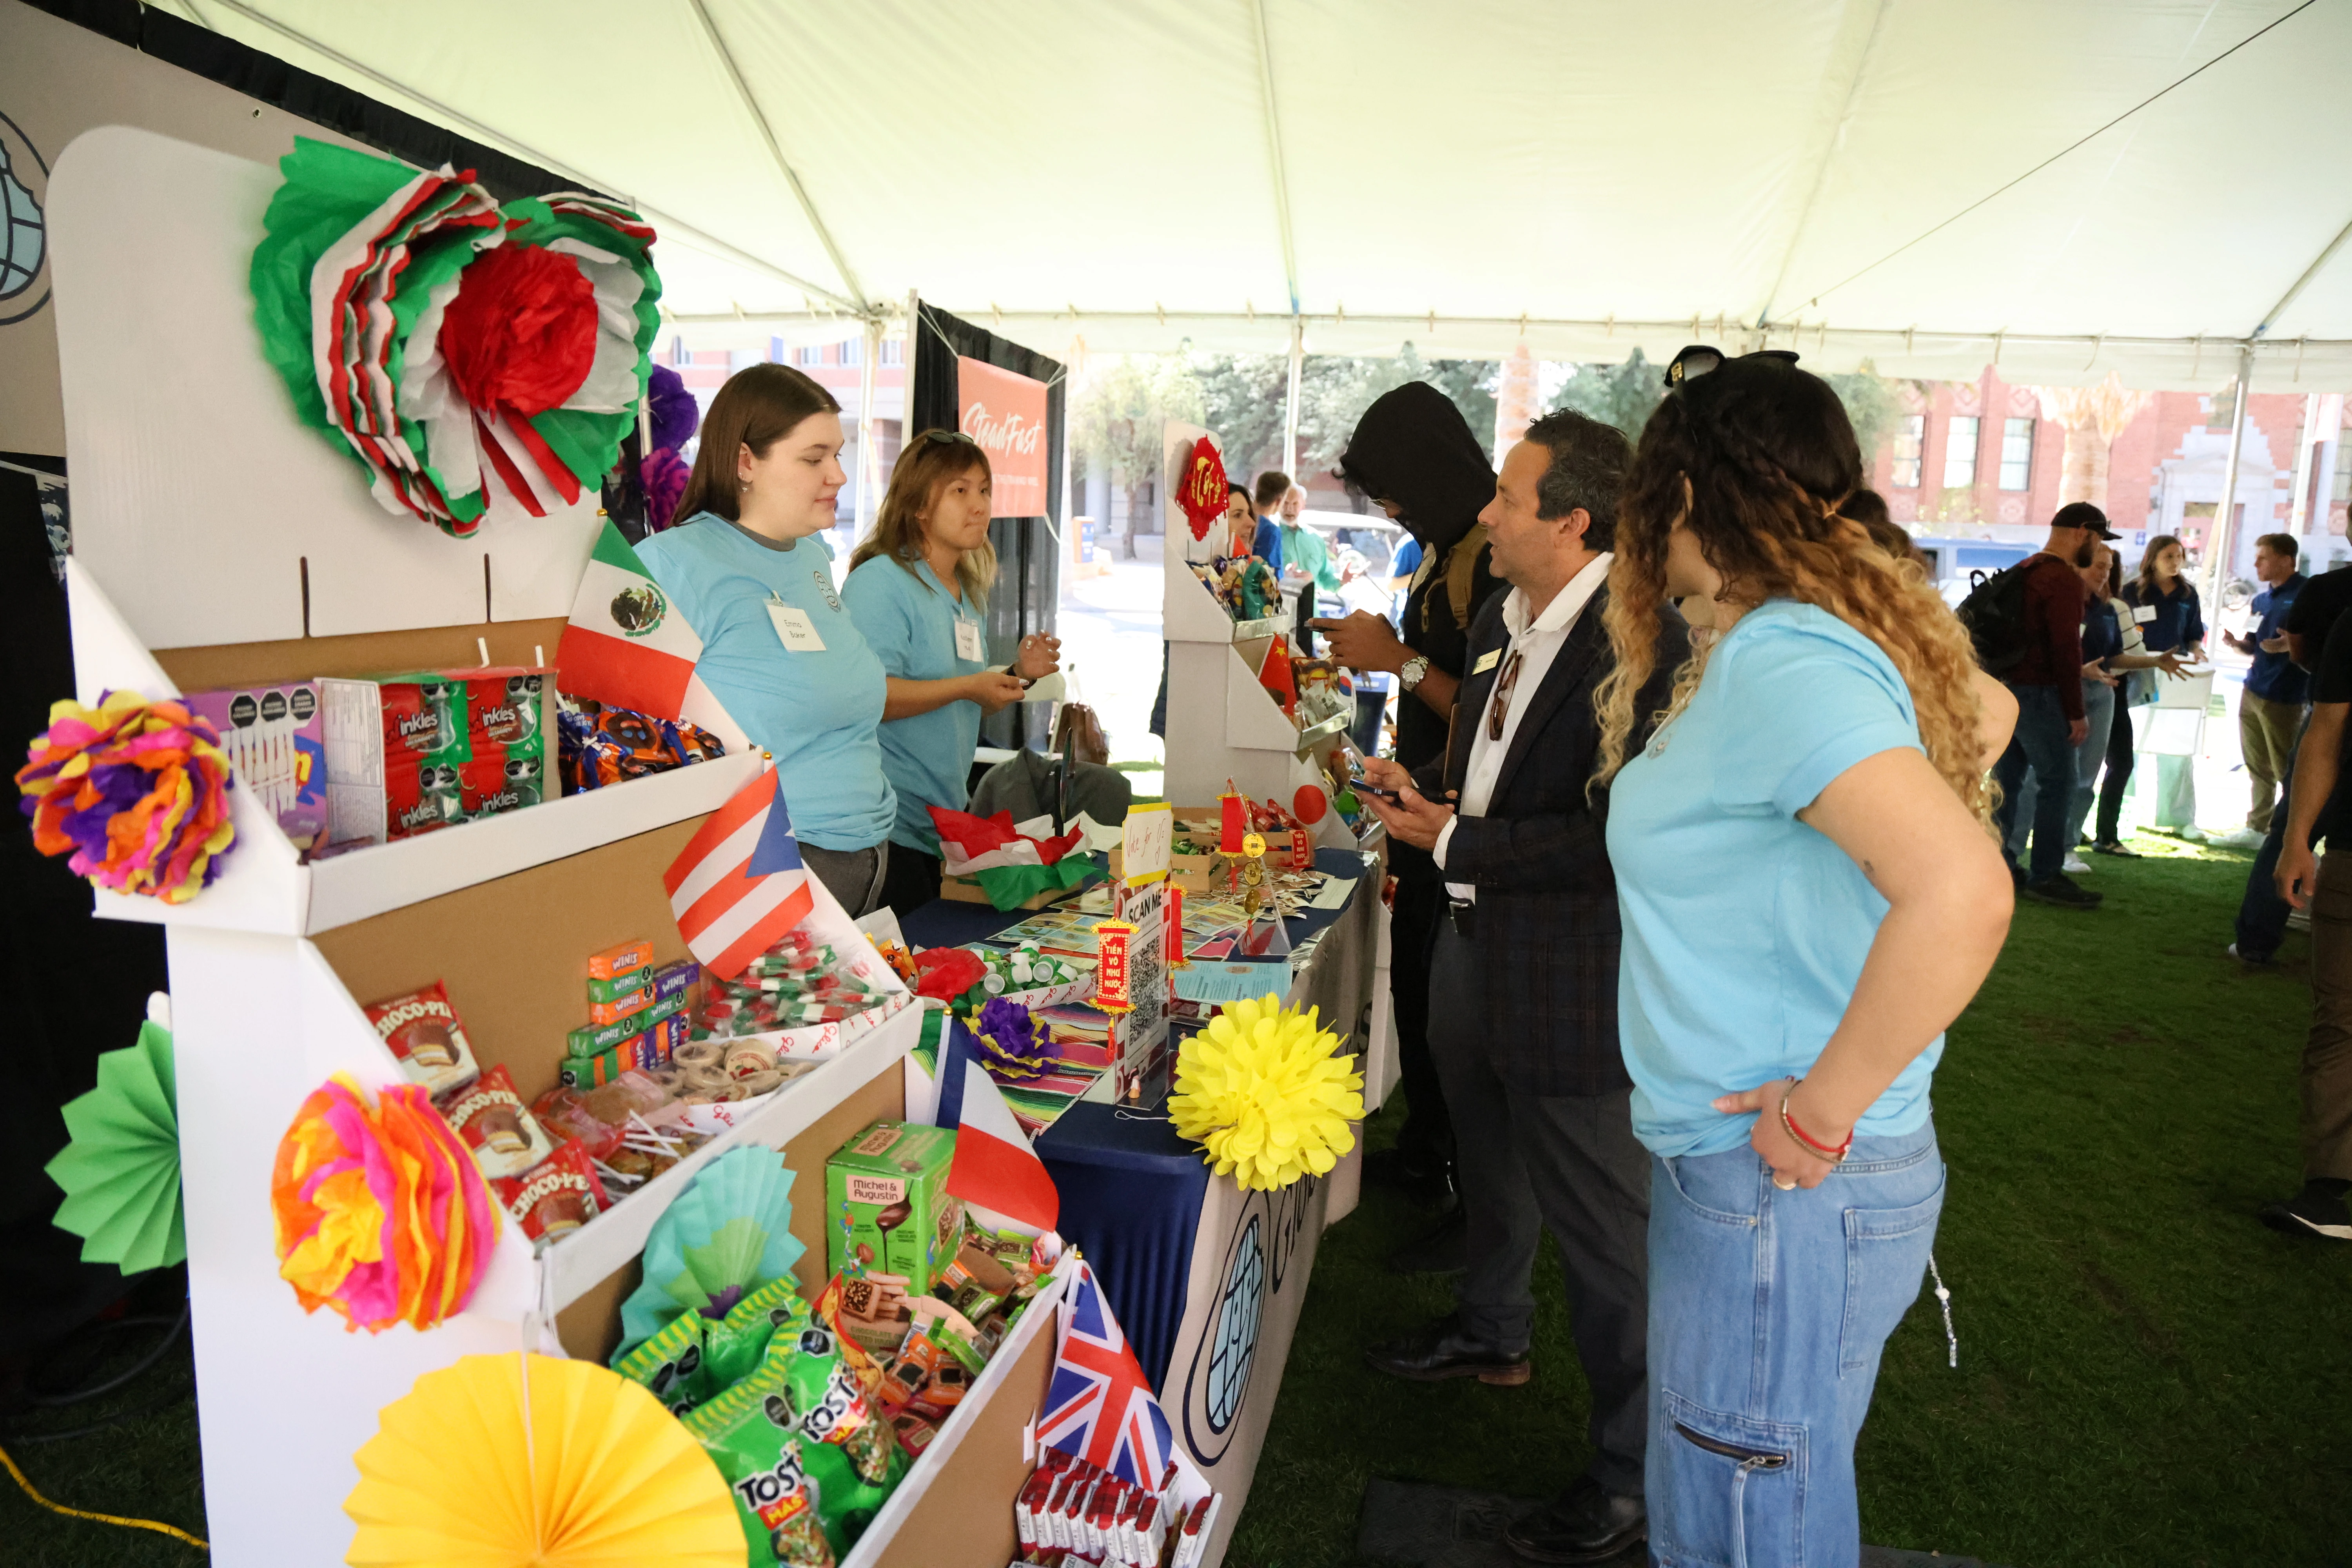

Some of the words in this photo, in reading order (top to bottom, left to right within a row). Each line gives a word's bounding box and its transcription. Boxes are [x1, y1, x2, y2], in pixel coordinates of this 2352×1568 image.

[1129, 896, 1150, 924] SCAN
[1152, 888, 1162, 912] ME
[612, 952, 638, 971] WINIS
[1109, 956, 1119, 966] VÔ
[614, 976, 637, 992] WINIS
[662, 974, 686, 993] WINIS
[615, 994, 640, 1012] WINIS
[1039, 988, 1057, 1006] Glico
[651, 1000, 672, 1017] WINIS
[594, 1027, 619, 1045] WINIS
[812, 1025, 837, 1054] Glico
[777, 1037, 794, 1056] Glic
[853, 1180, 887, 1191] Michel
[854, 1189, 898, 1201] Augustin
